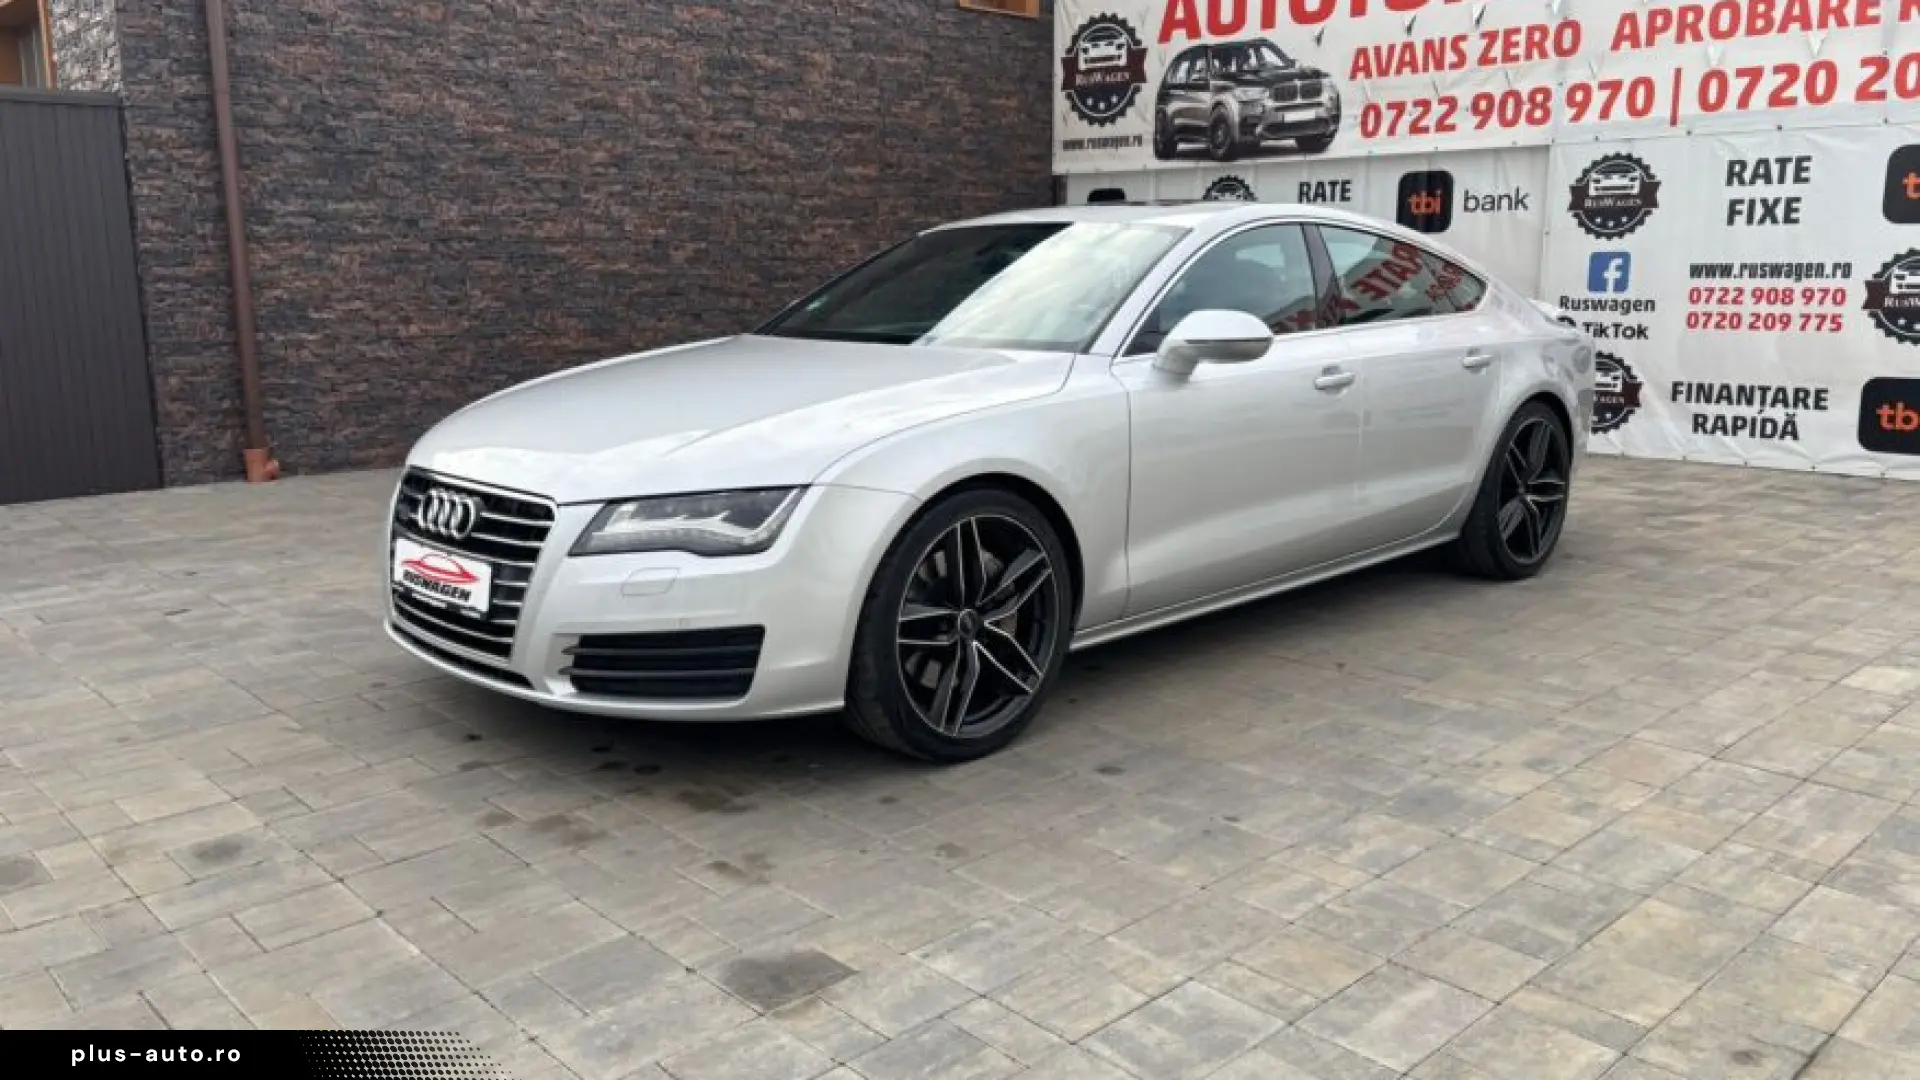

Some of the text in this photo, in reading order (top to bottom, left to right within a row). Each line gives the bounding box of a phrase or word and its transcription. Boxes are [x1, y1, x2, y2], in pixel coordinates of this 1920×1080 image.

[1350, 34, 1468, 79] AVANS
[1477, 19, 1581, 66] ZERO
[1611, 0, 1881, 51] APROBARE
[1360, 95, 1459, 139] 0722
[1471, 85, 1553, 130] 908
[1566, 76, 1656, 123] 970
[1698, 59, 1838, 113] 0720
[1725, 155, 1813, 187] RATE
[1297, 179, 1353, 204] RATE
[1408, 186, 1531, 216] tbi bank
[1726, 196, 1802, 226] FIXE
[1689, 262, 1853, 283] www.ruswagen.ro
[1559, 295, 1656, 316] Ruswagen
[1688, 286, 1847, 307] 0722 908 970
[1582, 321, 1648, 340] TikTok
[1686, 311, 1844, 333] 0720 209 775
[1691, 412, 1801, 441] RAPIDĂ
